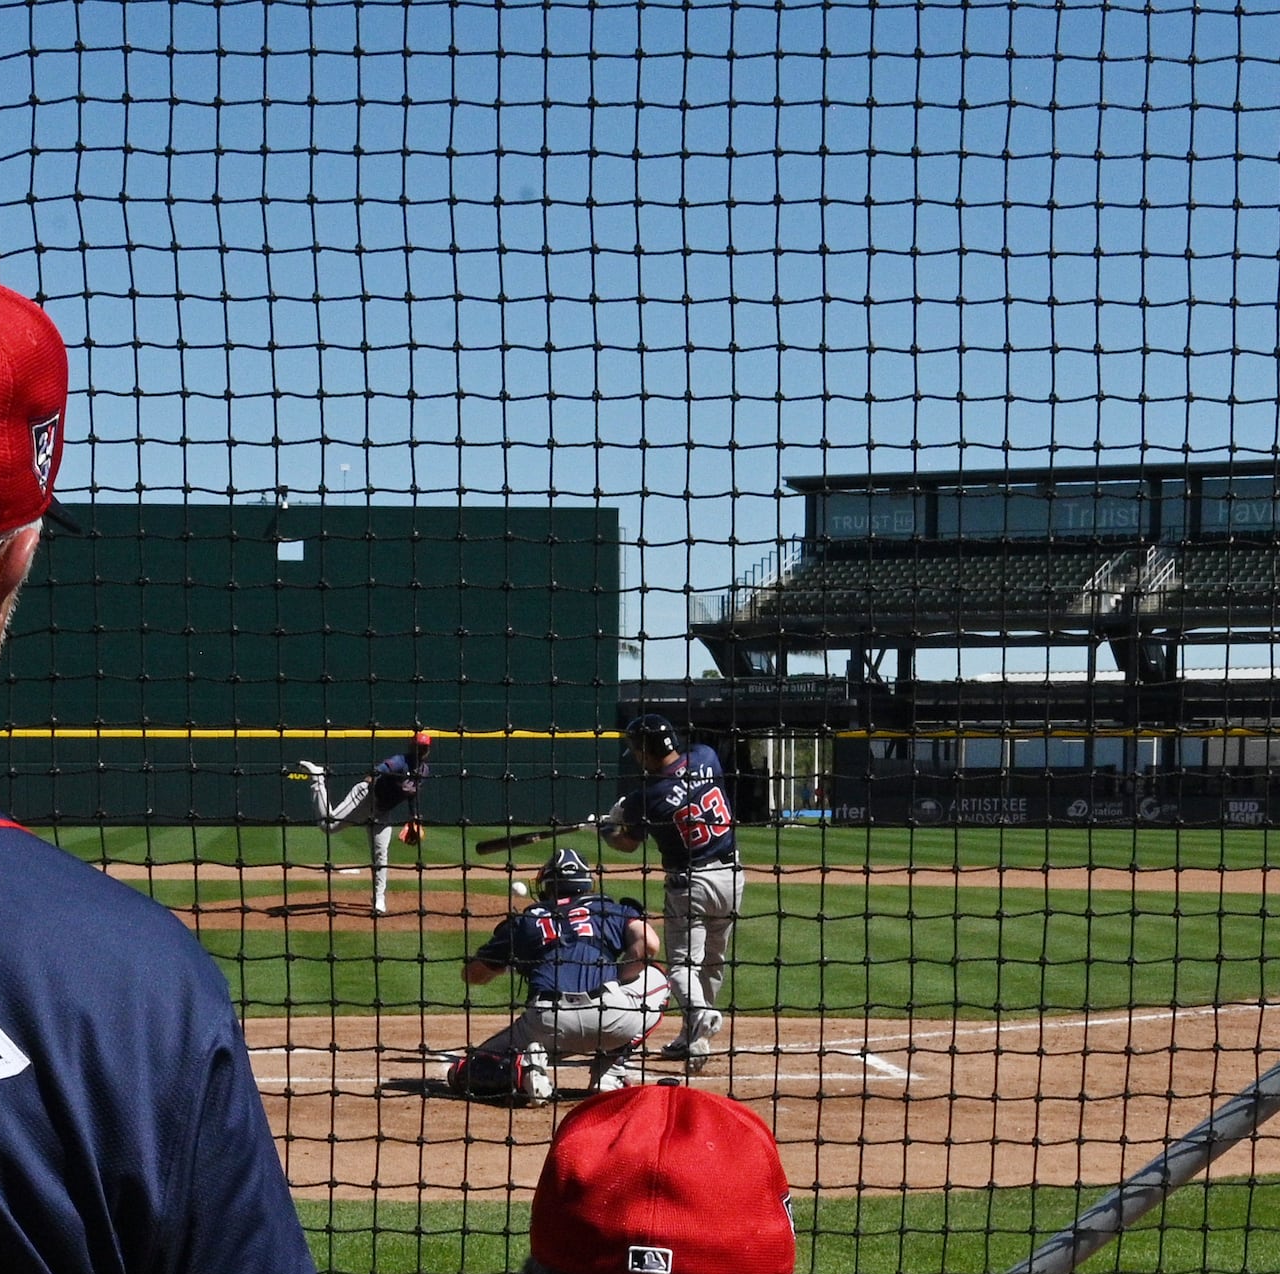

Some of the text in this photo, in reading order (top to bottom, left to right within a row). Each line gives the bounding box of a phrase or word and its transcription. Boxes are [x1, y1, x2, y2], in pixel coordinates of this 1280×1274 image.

[832, 514, 890, 529] TRUIST
[1062, 502, 1140, 528] Truist
[949, 798, 1027, 812] ARTISTREE
[1228, 801, 1259, 812] BUD
[672, 786, 733, 849] 63
